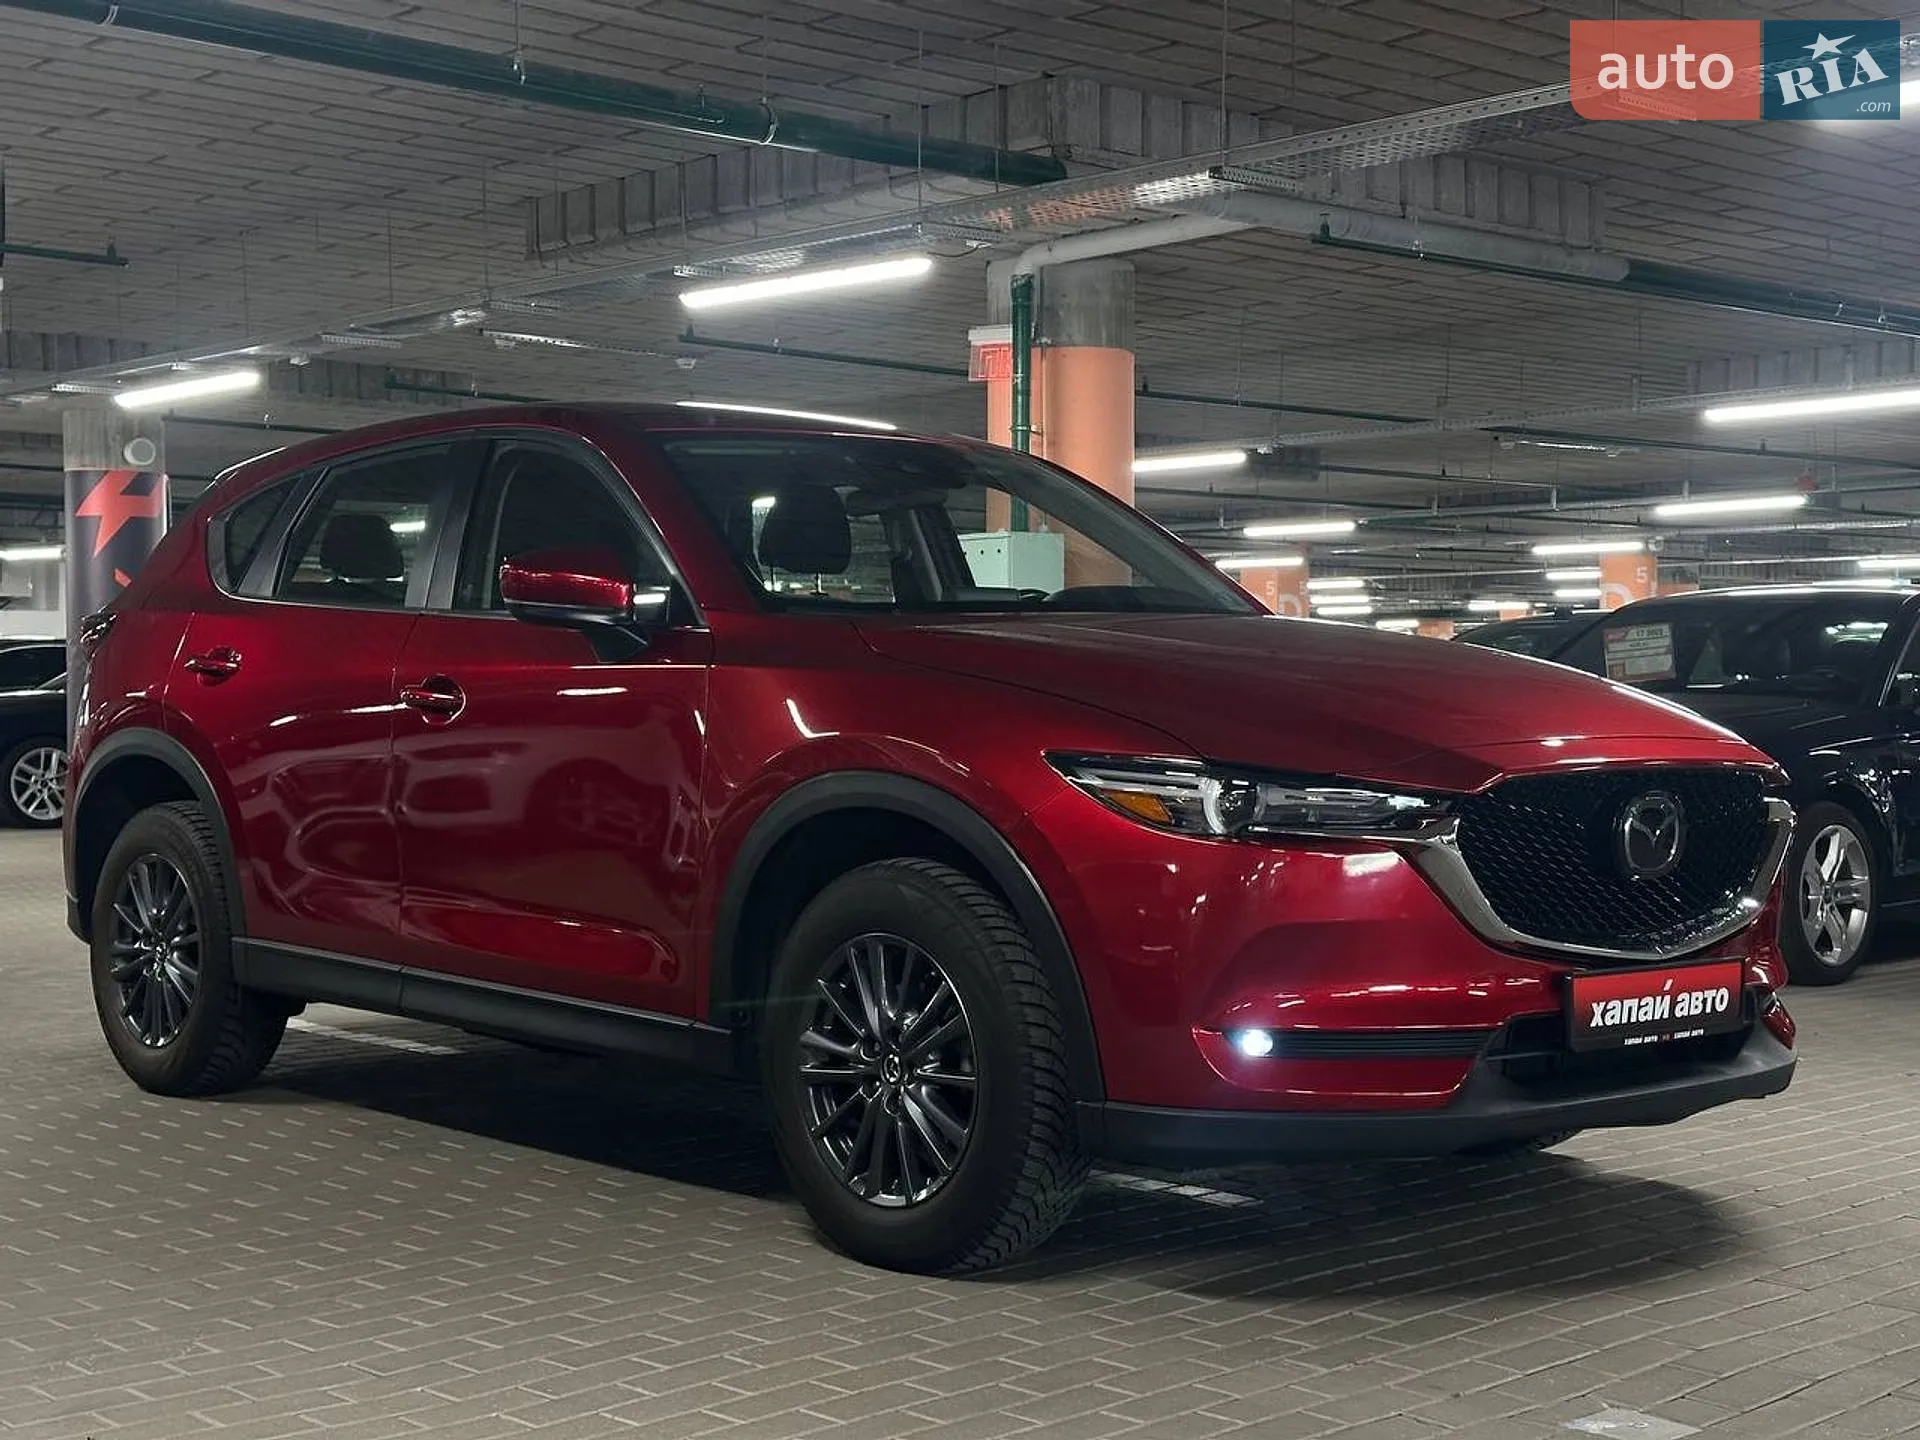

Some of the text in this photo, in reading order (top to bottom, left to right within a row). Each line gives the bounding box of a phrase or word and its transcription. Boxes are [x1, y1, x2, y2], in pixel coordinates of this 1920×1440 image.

[1635, 566, 1648, 584] 5
[1265, 580, 1276, 596] 5
[1674, 986, 1729, 1019] авто
